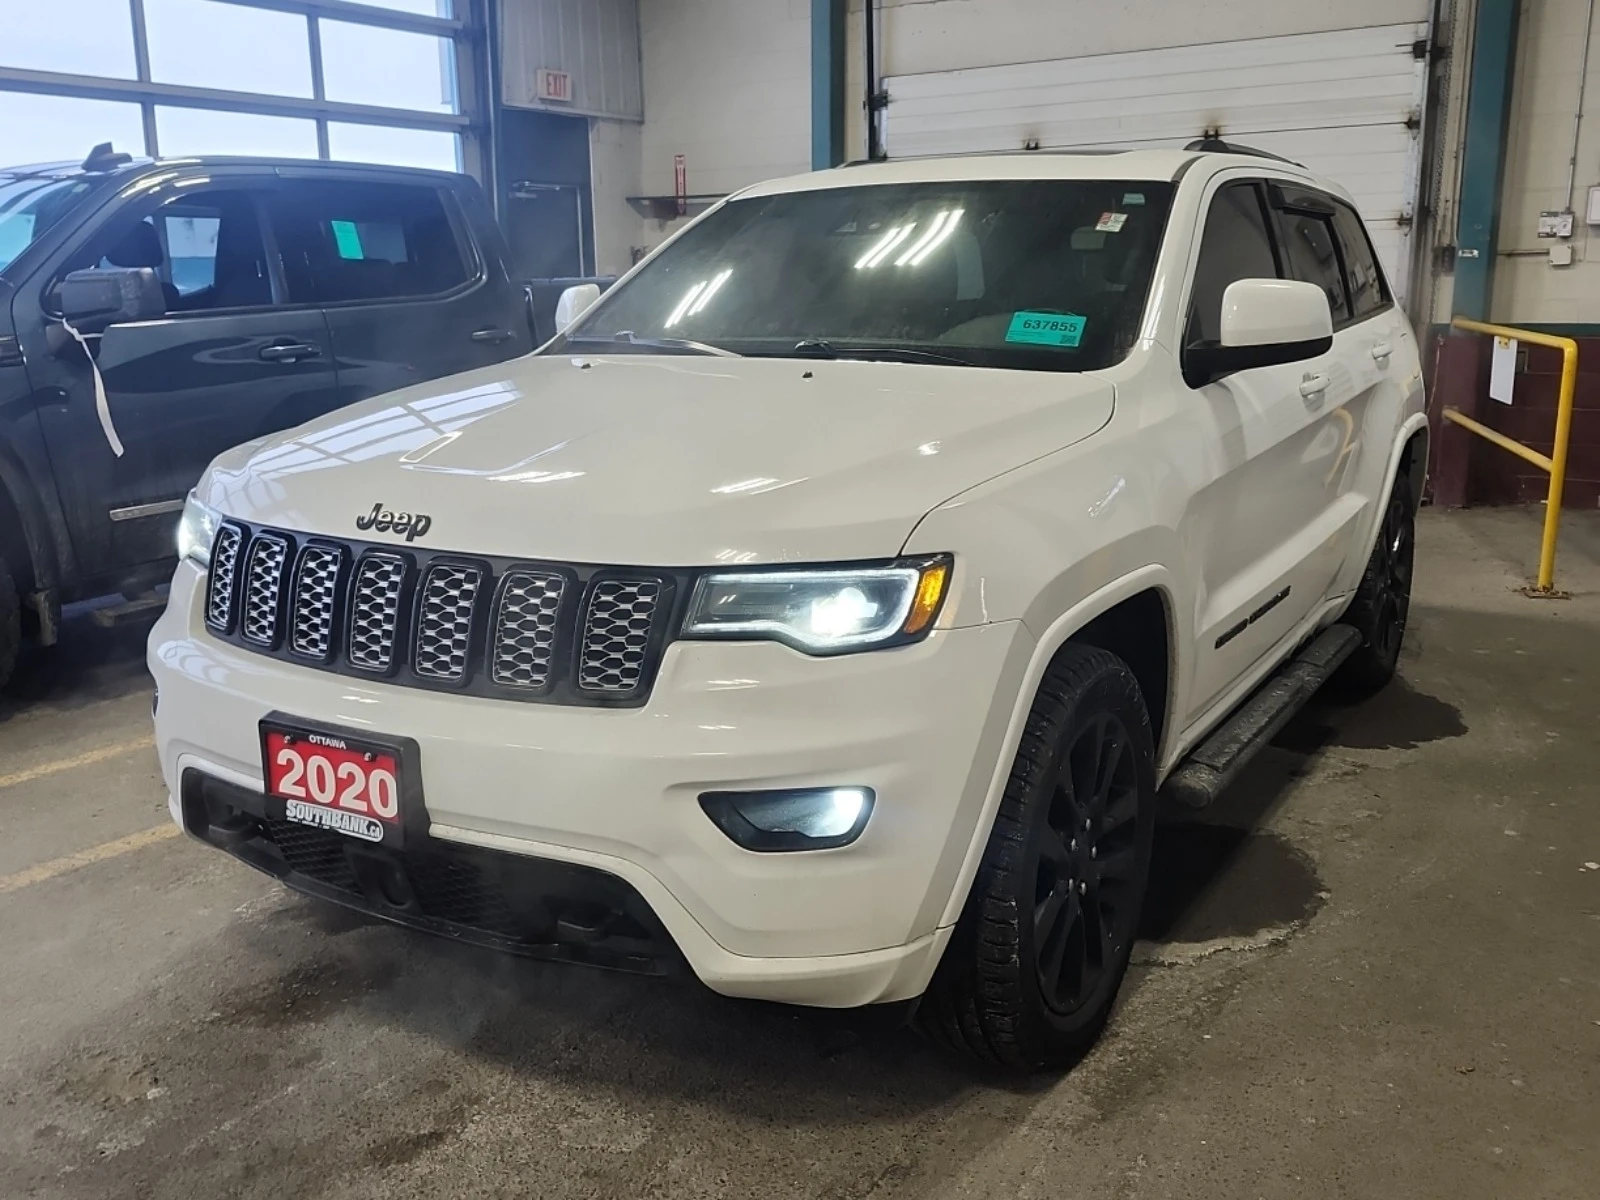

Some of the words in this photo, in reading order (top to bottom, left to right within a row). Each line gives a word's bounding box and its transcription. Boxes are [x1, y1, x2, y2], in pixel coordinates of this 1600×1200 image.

[546, 72, 568, 97] EXIT
[1023, 320, 1077, 333] 637855
[356, 502, 432, 542] Jeep
[308, 734, 347, 750] OTTAWA
[276, 748, 398, 818] 2020
